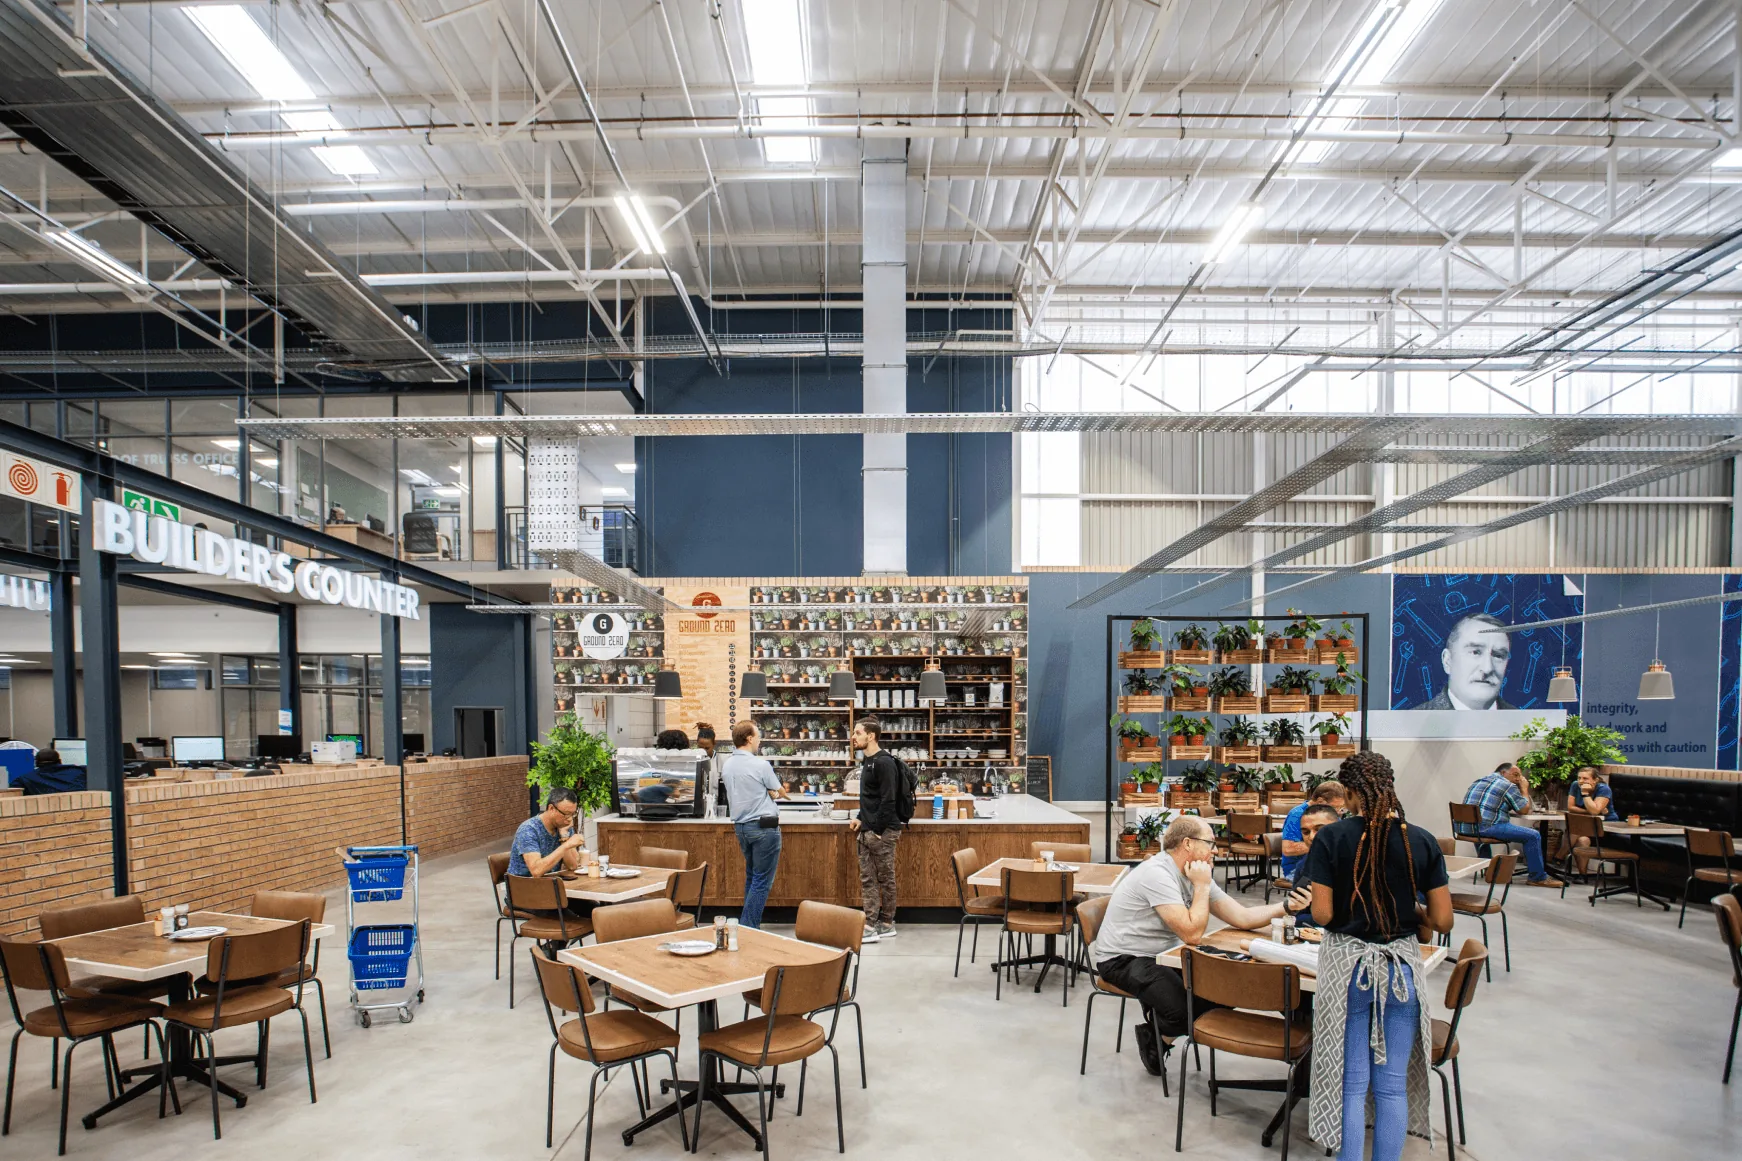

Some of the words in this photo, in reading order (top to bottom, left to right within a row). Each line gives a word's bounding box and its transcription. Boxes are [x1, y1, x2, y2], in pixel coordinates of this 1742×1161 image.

[193, 453, 239, 464] OFFICE
[94, 498, 294, 593] BUILDERS
[296, 561, 420, 620] COUNTER
[599, 618, 607, 630] G
[678, 620, 710, 633] GROUND
[714, 620, 736, 633] ZERO
[583, 635, 606, 646] GROUND
[609, 635, 624, 646] ZERO
[1586, 702, 1639, 716] integrity,
[1615, 721, 1643, 733] work
[1645, 721, 1667, 733] and
[1637, 740, 1662, 753] with
[1664, 741, 1707, 753] caution
